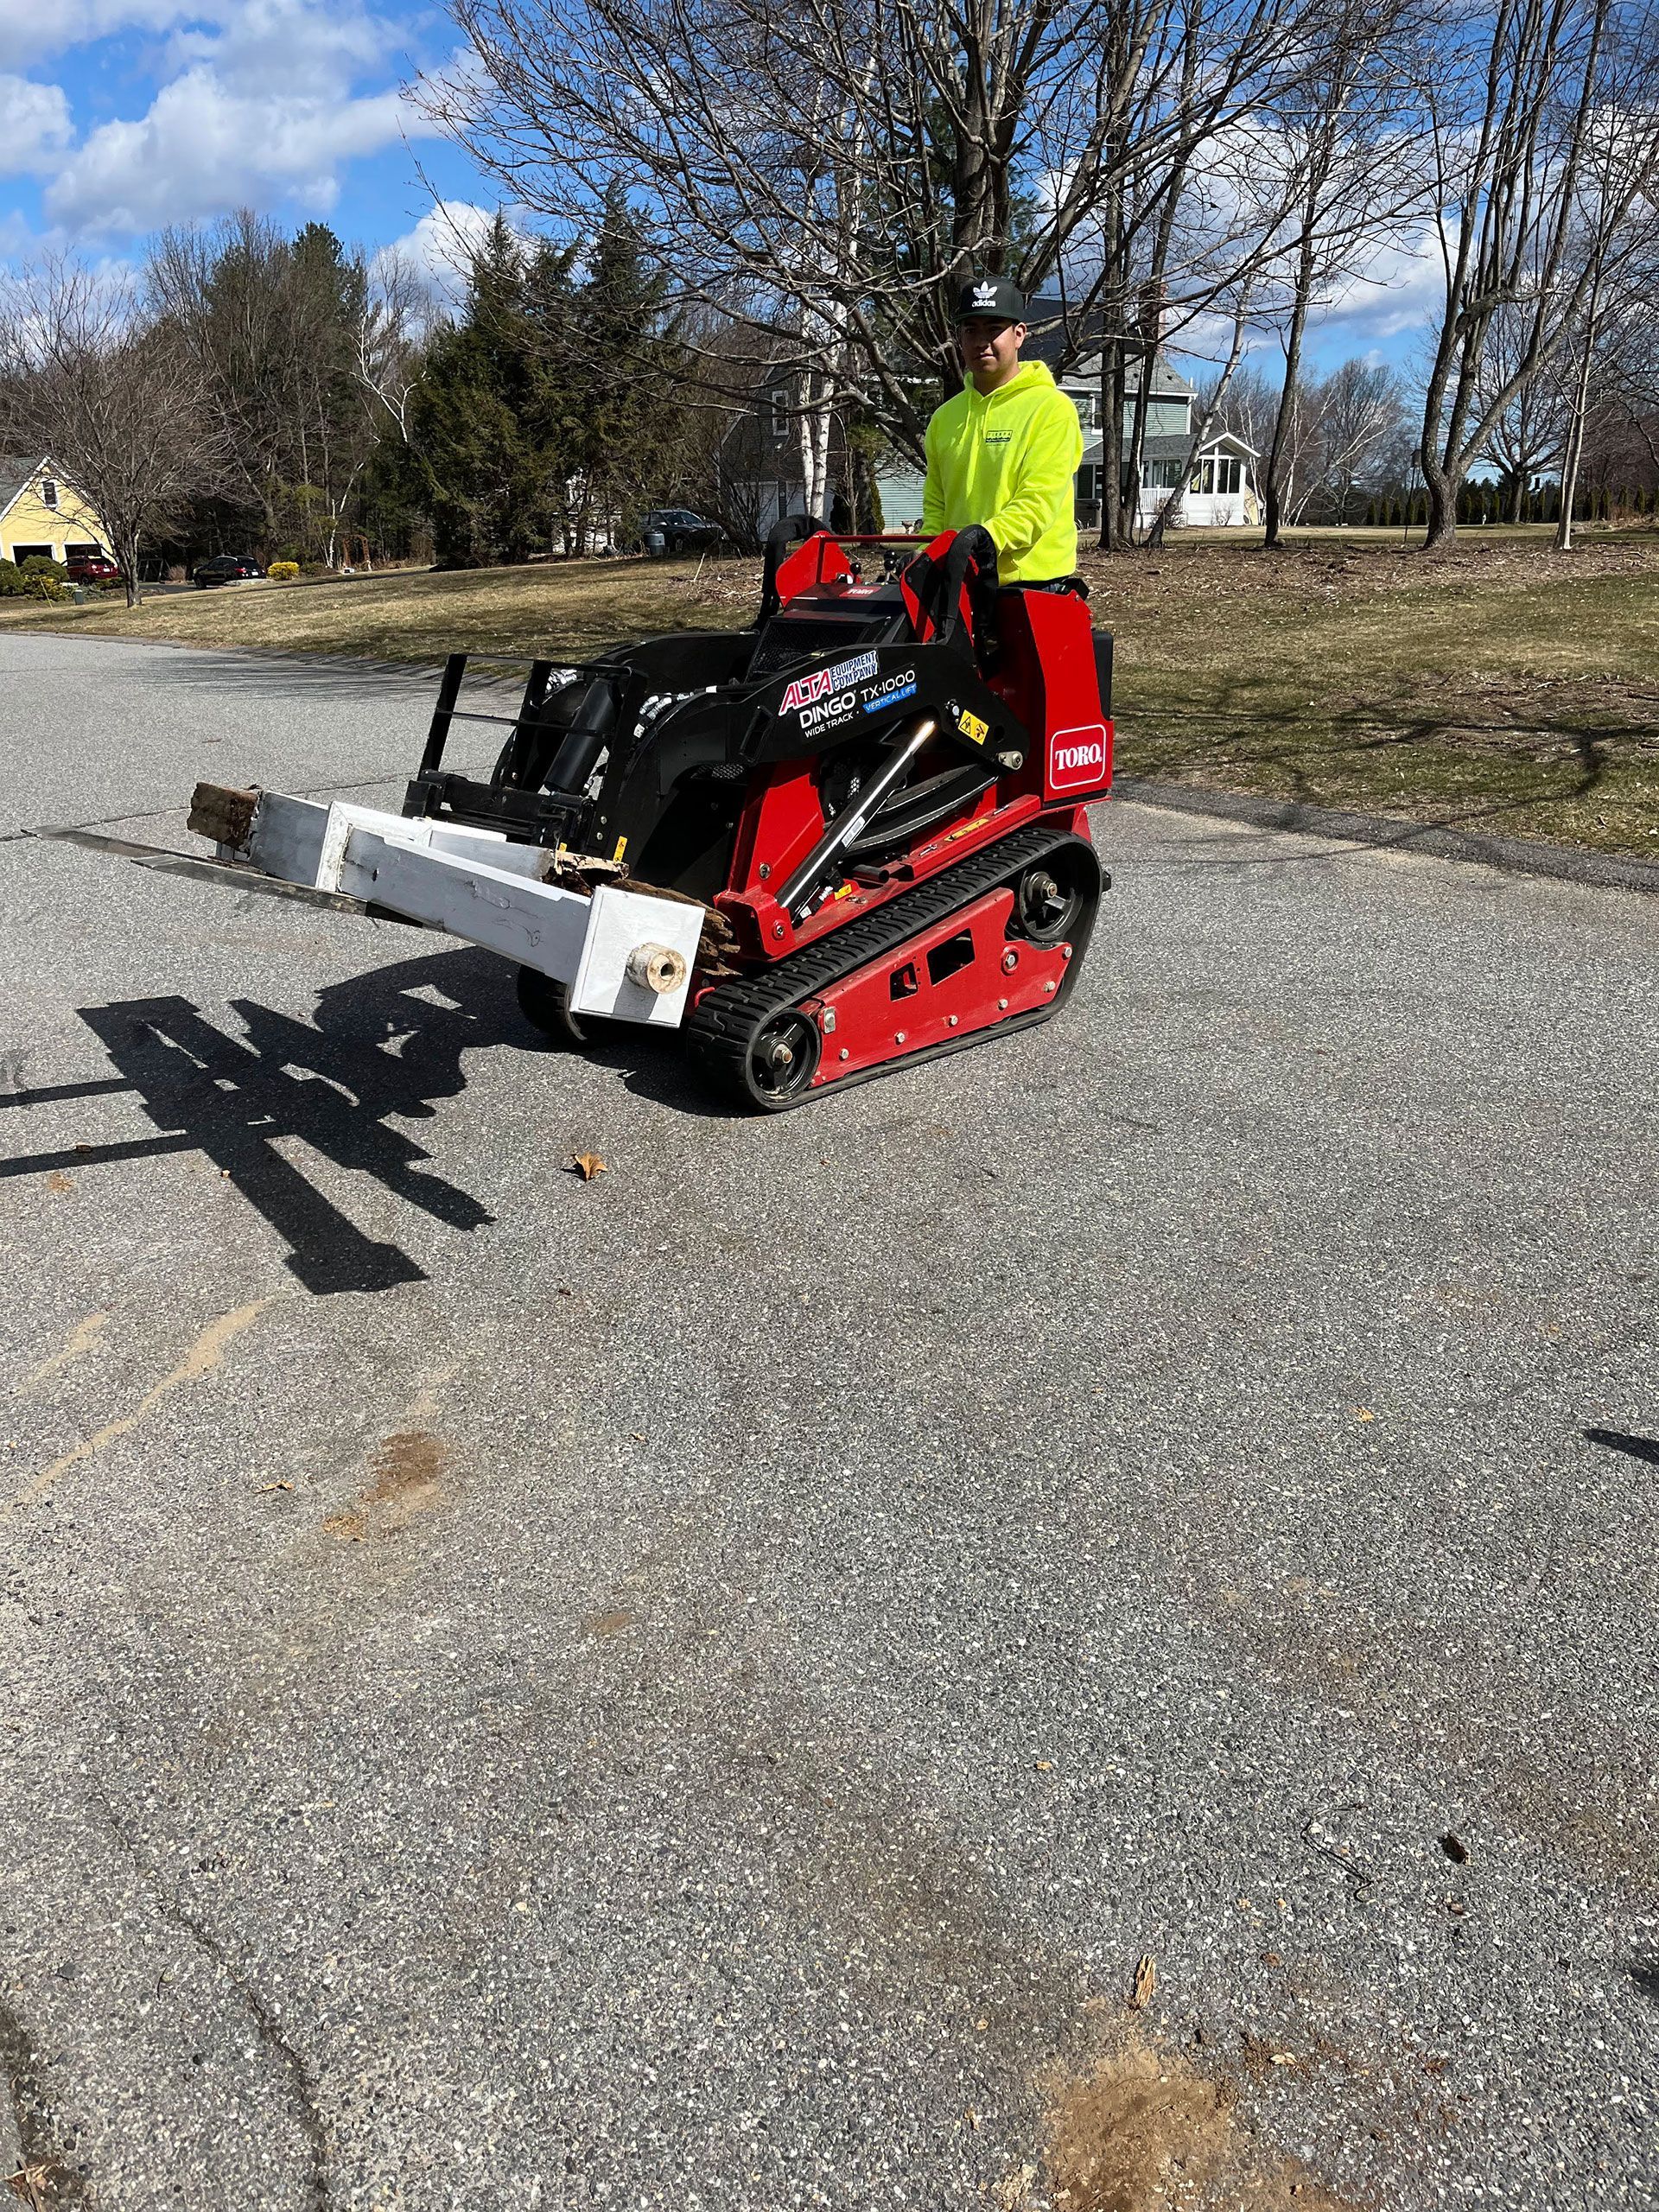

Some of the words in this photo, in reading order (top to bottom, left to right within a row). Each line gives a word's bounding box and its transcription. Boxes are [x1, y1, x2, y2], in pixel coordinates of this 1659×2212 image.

[972, 299, 996, 308] adidas
[830, 651, 877, 677] EQUIPMENT
[833, 663, 878, 690] COMPANY
[779, 668, 834, 716] ALTA
[865, 691, 900, 711] VERTICAL
[901, 684, 917, 697] LIFT
[799, 692, 856, 728] DINGO
[804, 724, 826, 738] WIDE
[826, 712, 854, 729] TRACK
[1055, 743, 1102, 770] TORO
